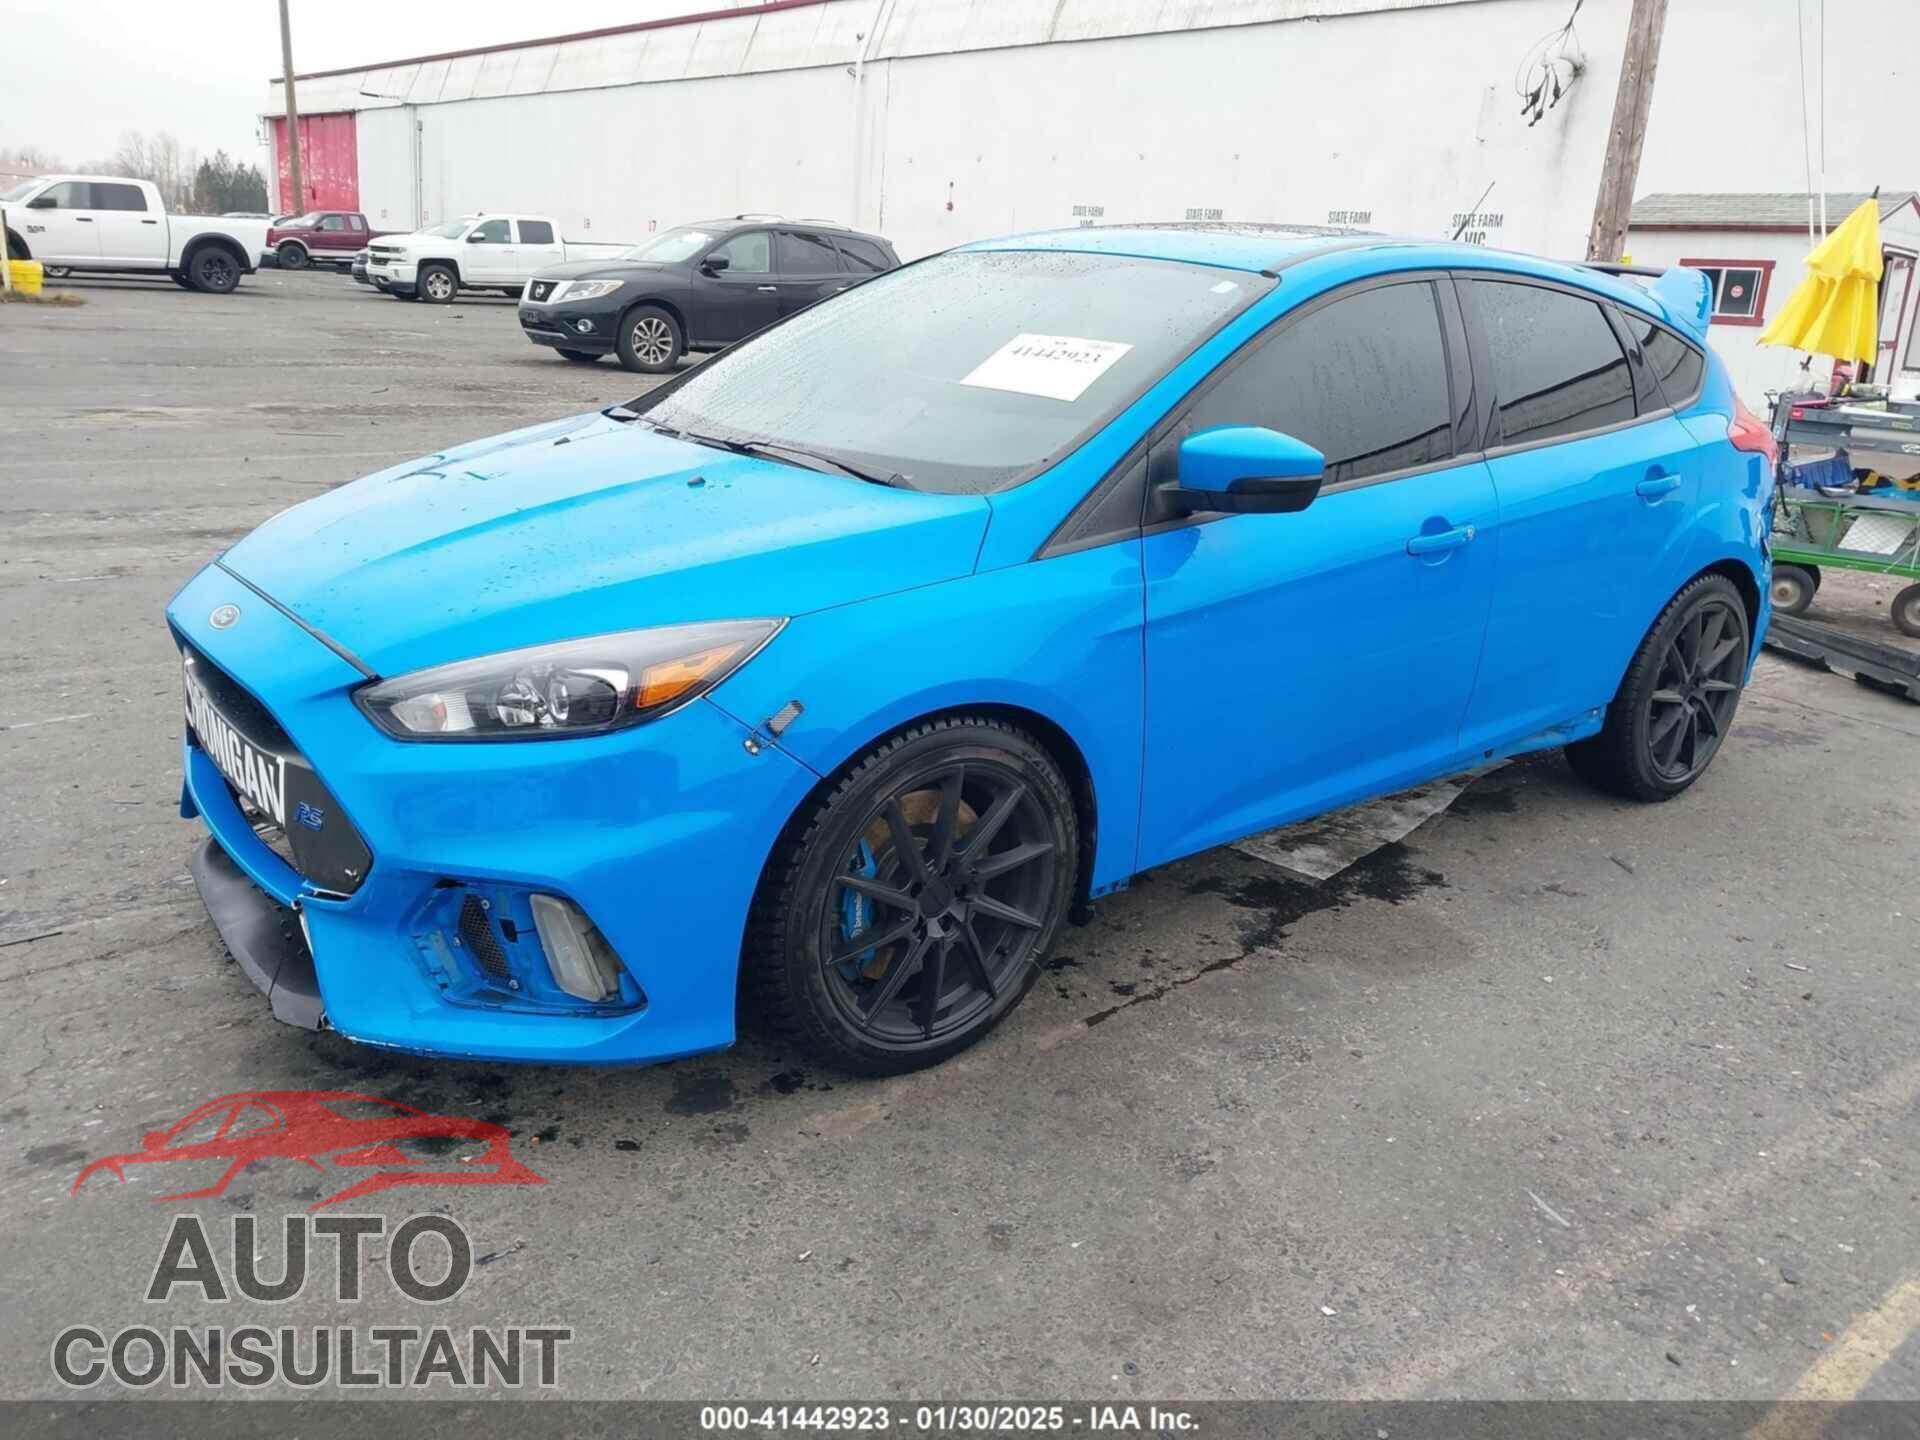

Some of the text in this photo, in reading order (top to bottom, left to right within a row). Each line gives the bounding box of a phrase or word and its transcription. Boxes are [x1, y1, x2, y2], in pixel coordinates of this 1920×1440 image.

[1185, 208, 1223, 221] STATE FARM
[1327, 211, 1372, 225] STATE FARM
[1452, 213, 1503, 228] STATE FARM
